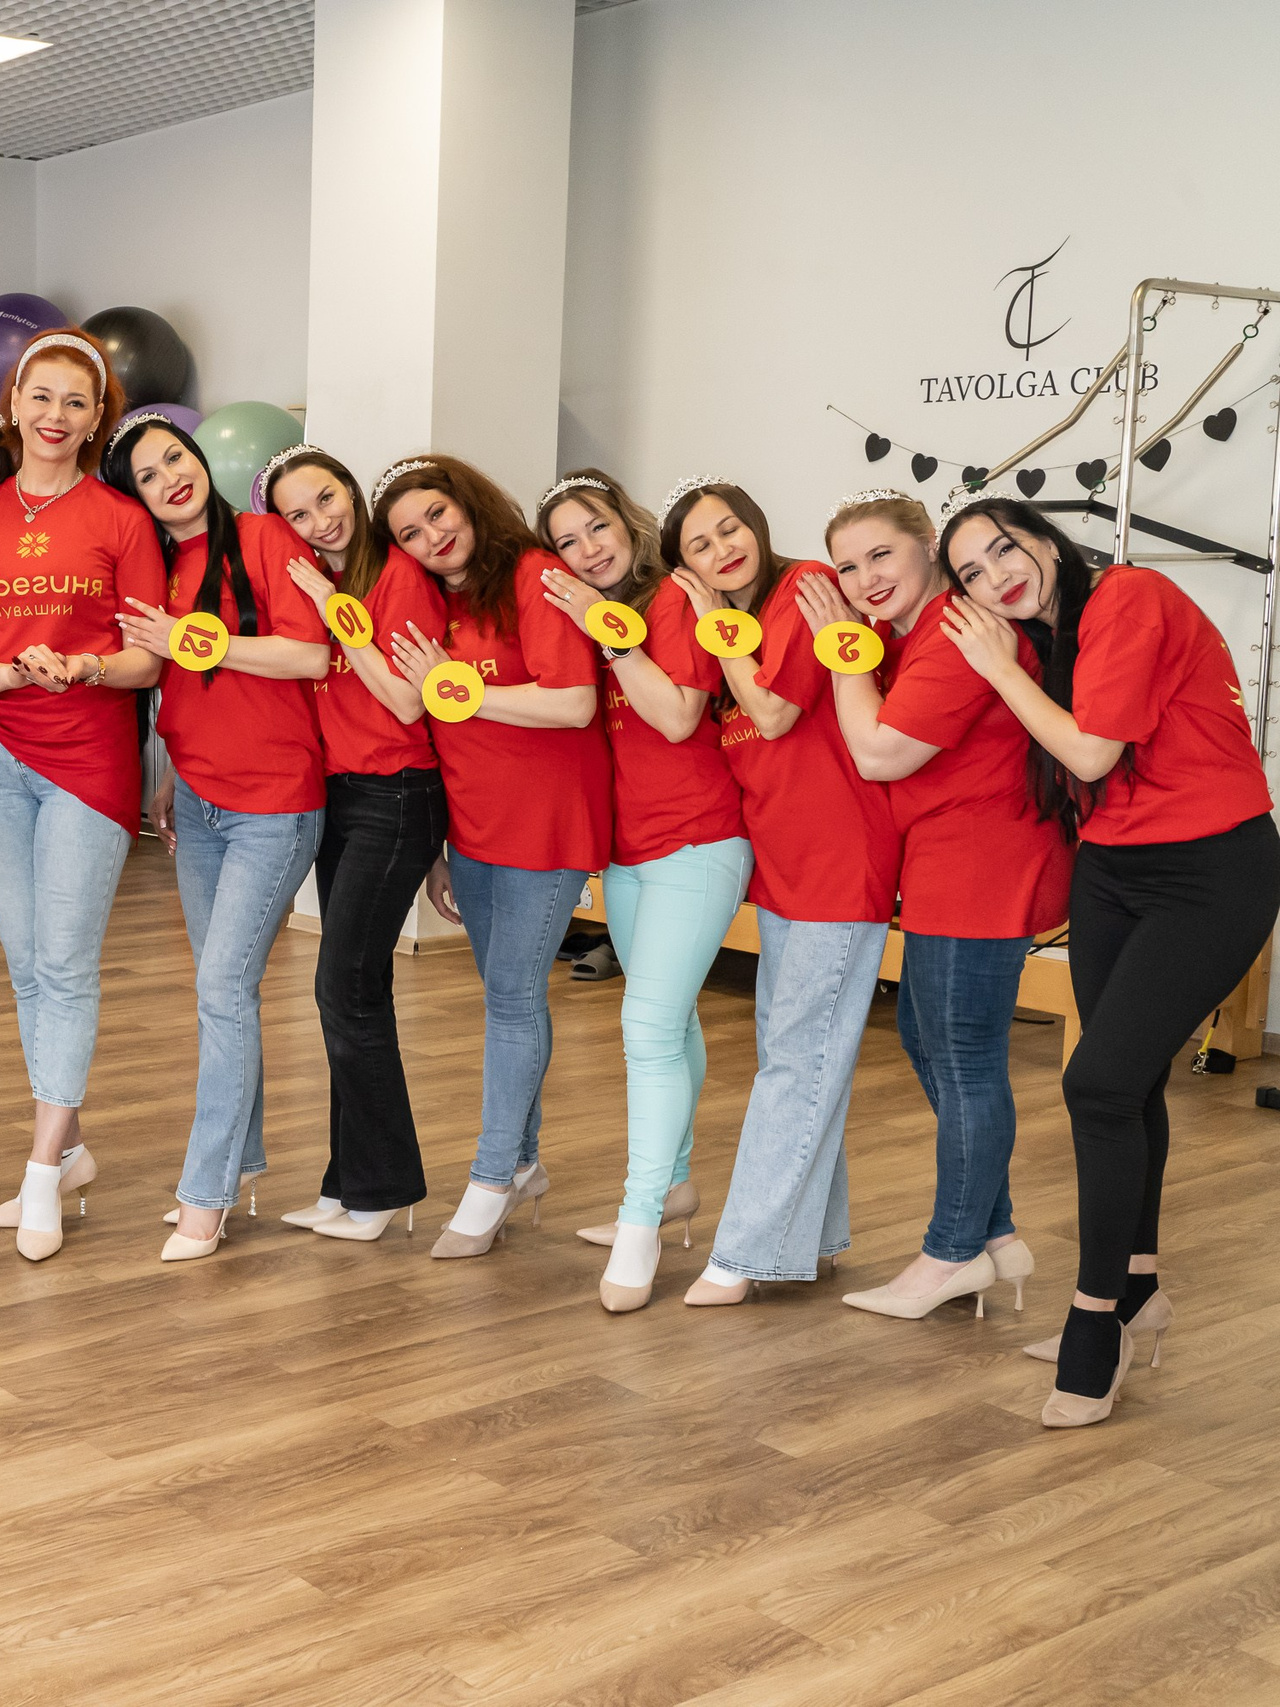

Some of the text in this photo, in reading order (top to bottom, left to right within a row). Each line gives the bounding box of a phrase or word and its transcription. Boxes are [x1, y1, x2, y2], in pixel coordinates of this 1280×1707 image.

[919, 369, 1060, 404] TAVOLGA
[335, 602, 366, 638] 10
[714, 619, 739, 647] 4
[178, 624, 219, 658] 12
[436, 679, 470, 703] 8
